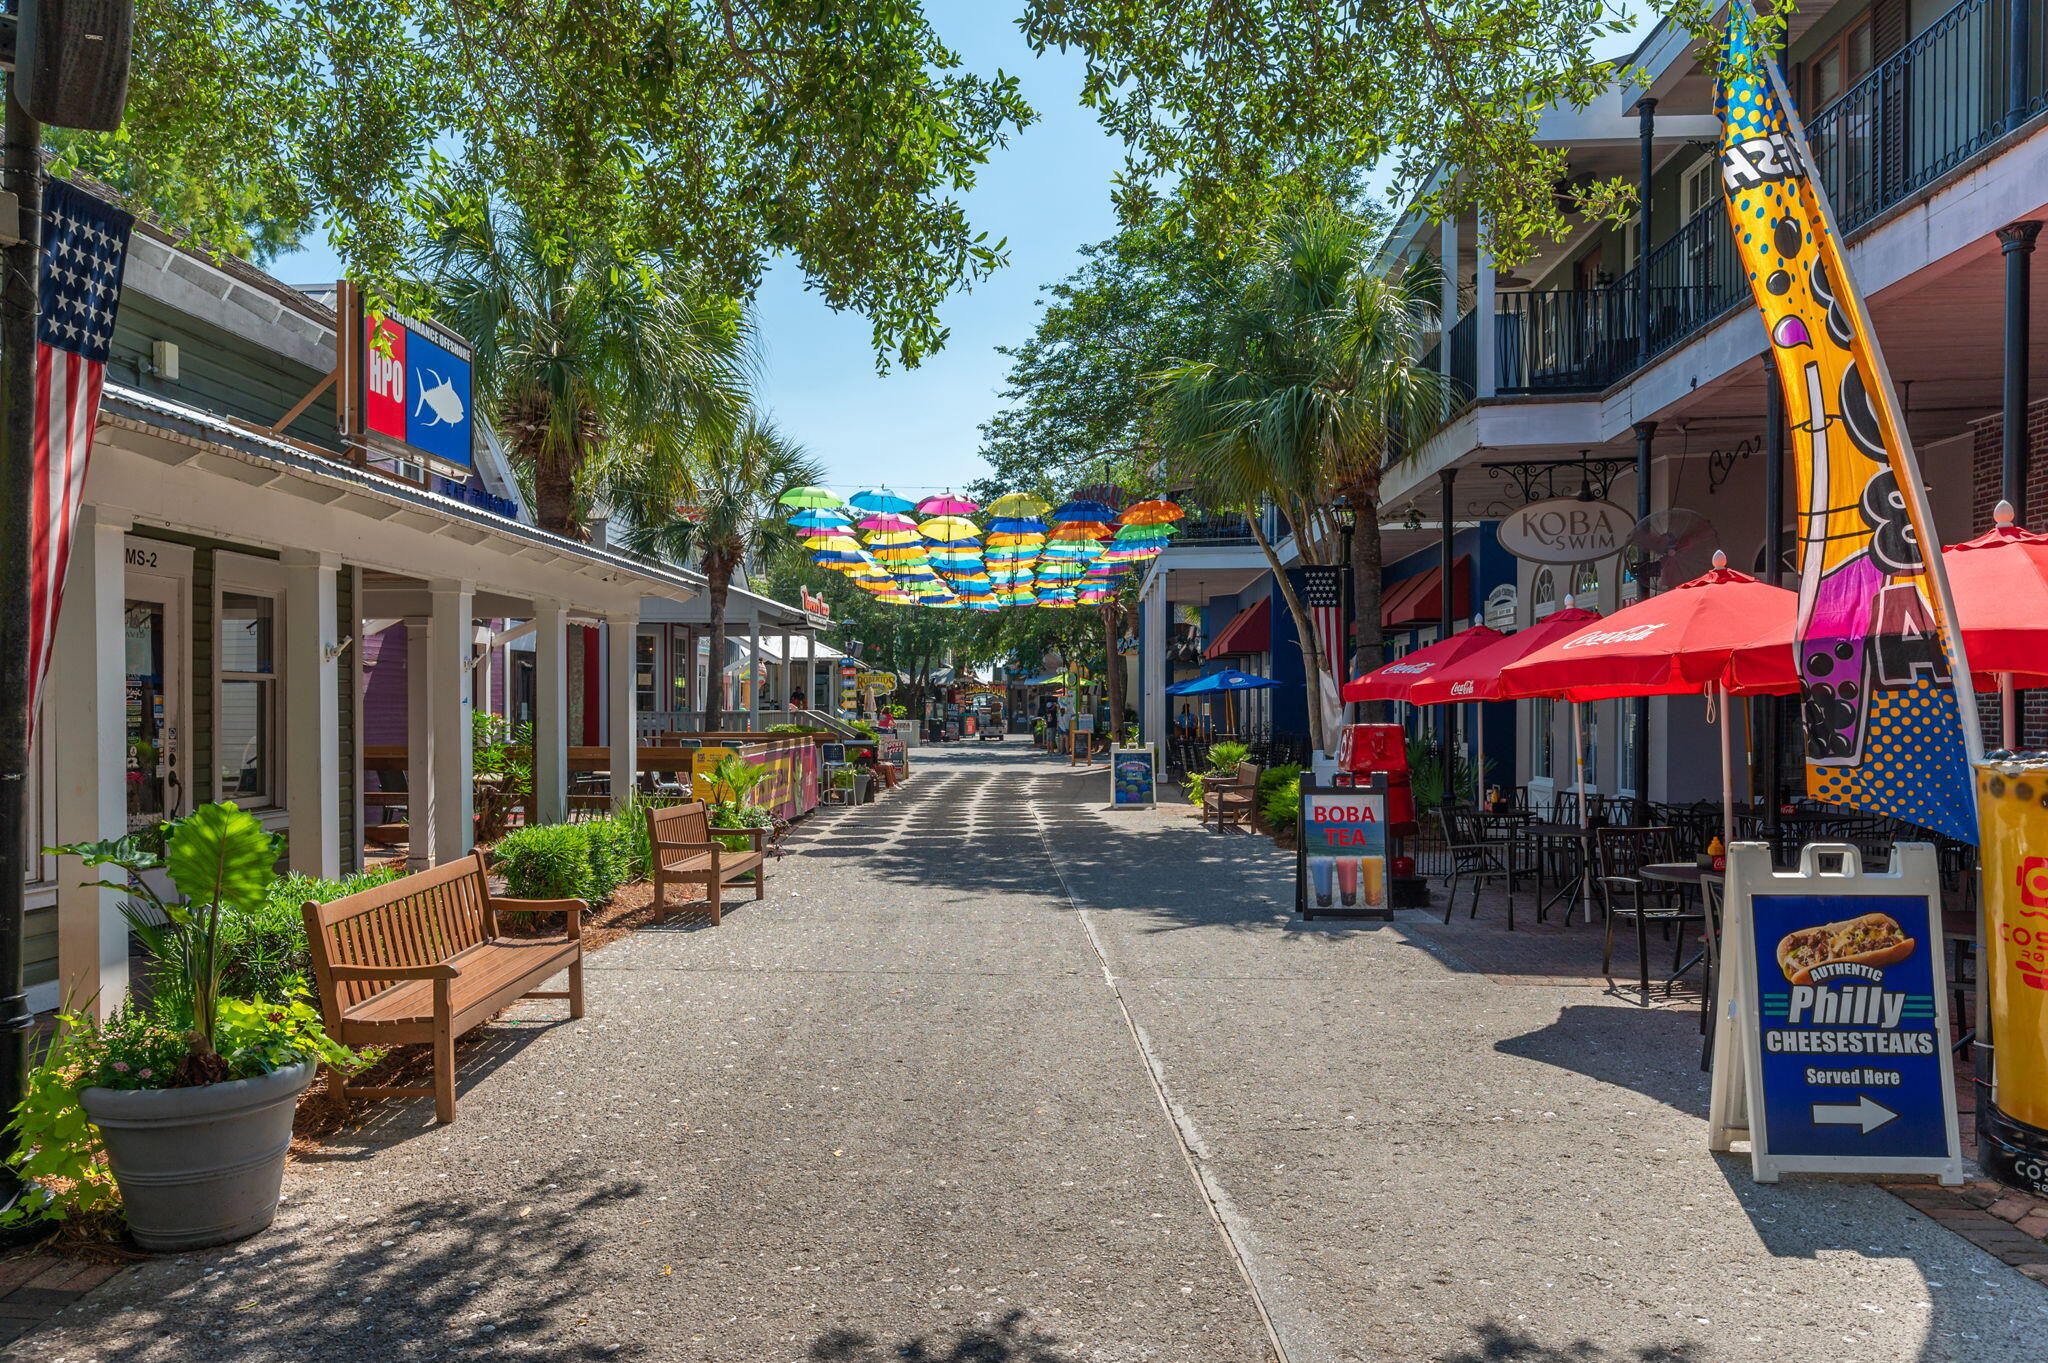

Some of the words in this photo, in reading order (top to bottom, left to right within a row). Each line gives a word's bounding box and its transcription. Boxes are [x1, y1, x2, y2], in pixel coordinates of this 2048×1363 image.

[439, 334, 472, 362] OFFSHORE
[369, 349, 404, 404] HPO
[1522, 510, 1614, 546] KOBA
[1555, 534, 1616, 551] SWIM
[125, 548, 157, 568] MS-2
[1562, 623, 1670, 650] Coca-Cola
[1450, 680, 1475, 696] Coca-Cola
[1314, 806, 1376, 824] BOBA
[1323, 828, 1367, 846] TEA
[1810, 963, 1883, 982] AUTHENTIC
[1788, 985, 1906, 1029] Philly
[1766, 1031, 1934, 1055] CHEESESTEAKS
[1806, 1068, 1860, 1085] Served
[1863, 1069, 1901, 1086] Here
